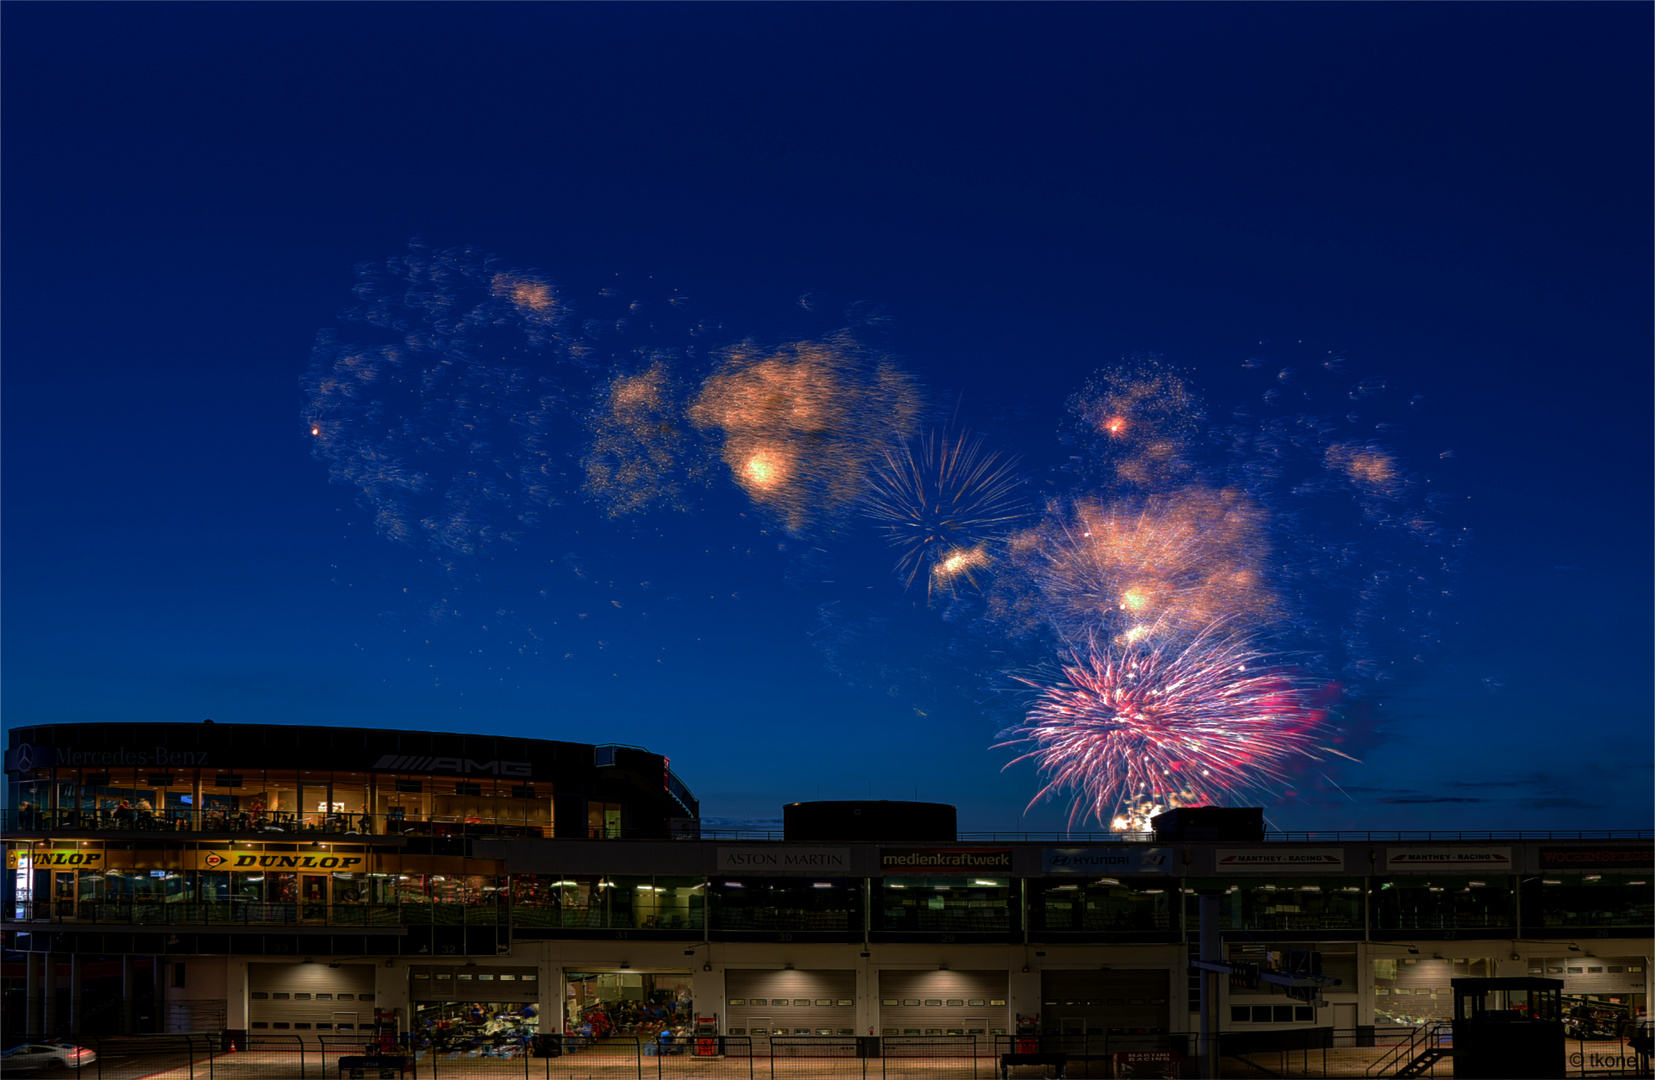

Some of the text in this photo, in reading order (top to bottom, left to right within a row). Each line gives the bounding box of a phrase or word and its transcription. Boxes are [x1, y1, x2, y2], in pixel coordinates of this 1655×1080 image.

[55, 746, 208, 766] Mercedes-Benz
[424, 756, 532, 777] AMG
[233, 855, 362, 869] DUNLOP
[726, 854, 842, 865] ASTON MARTIN
[882, 853, 1010, 866] medienkraftwerk
[1073, 856, 1129, 865] HYUNDAI
